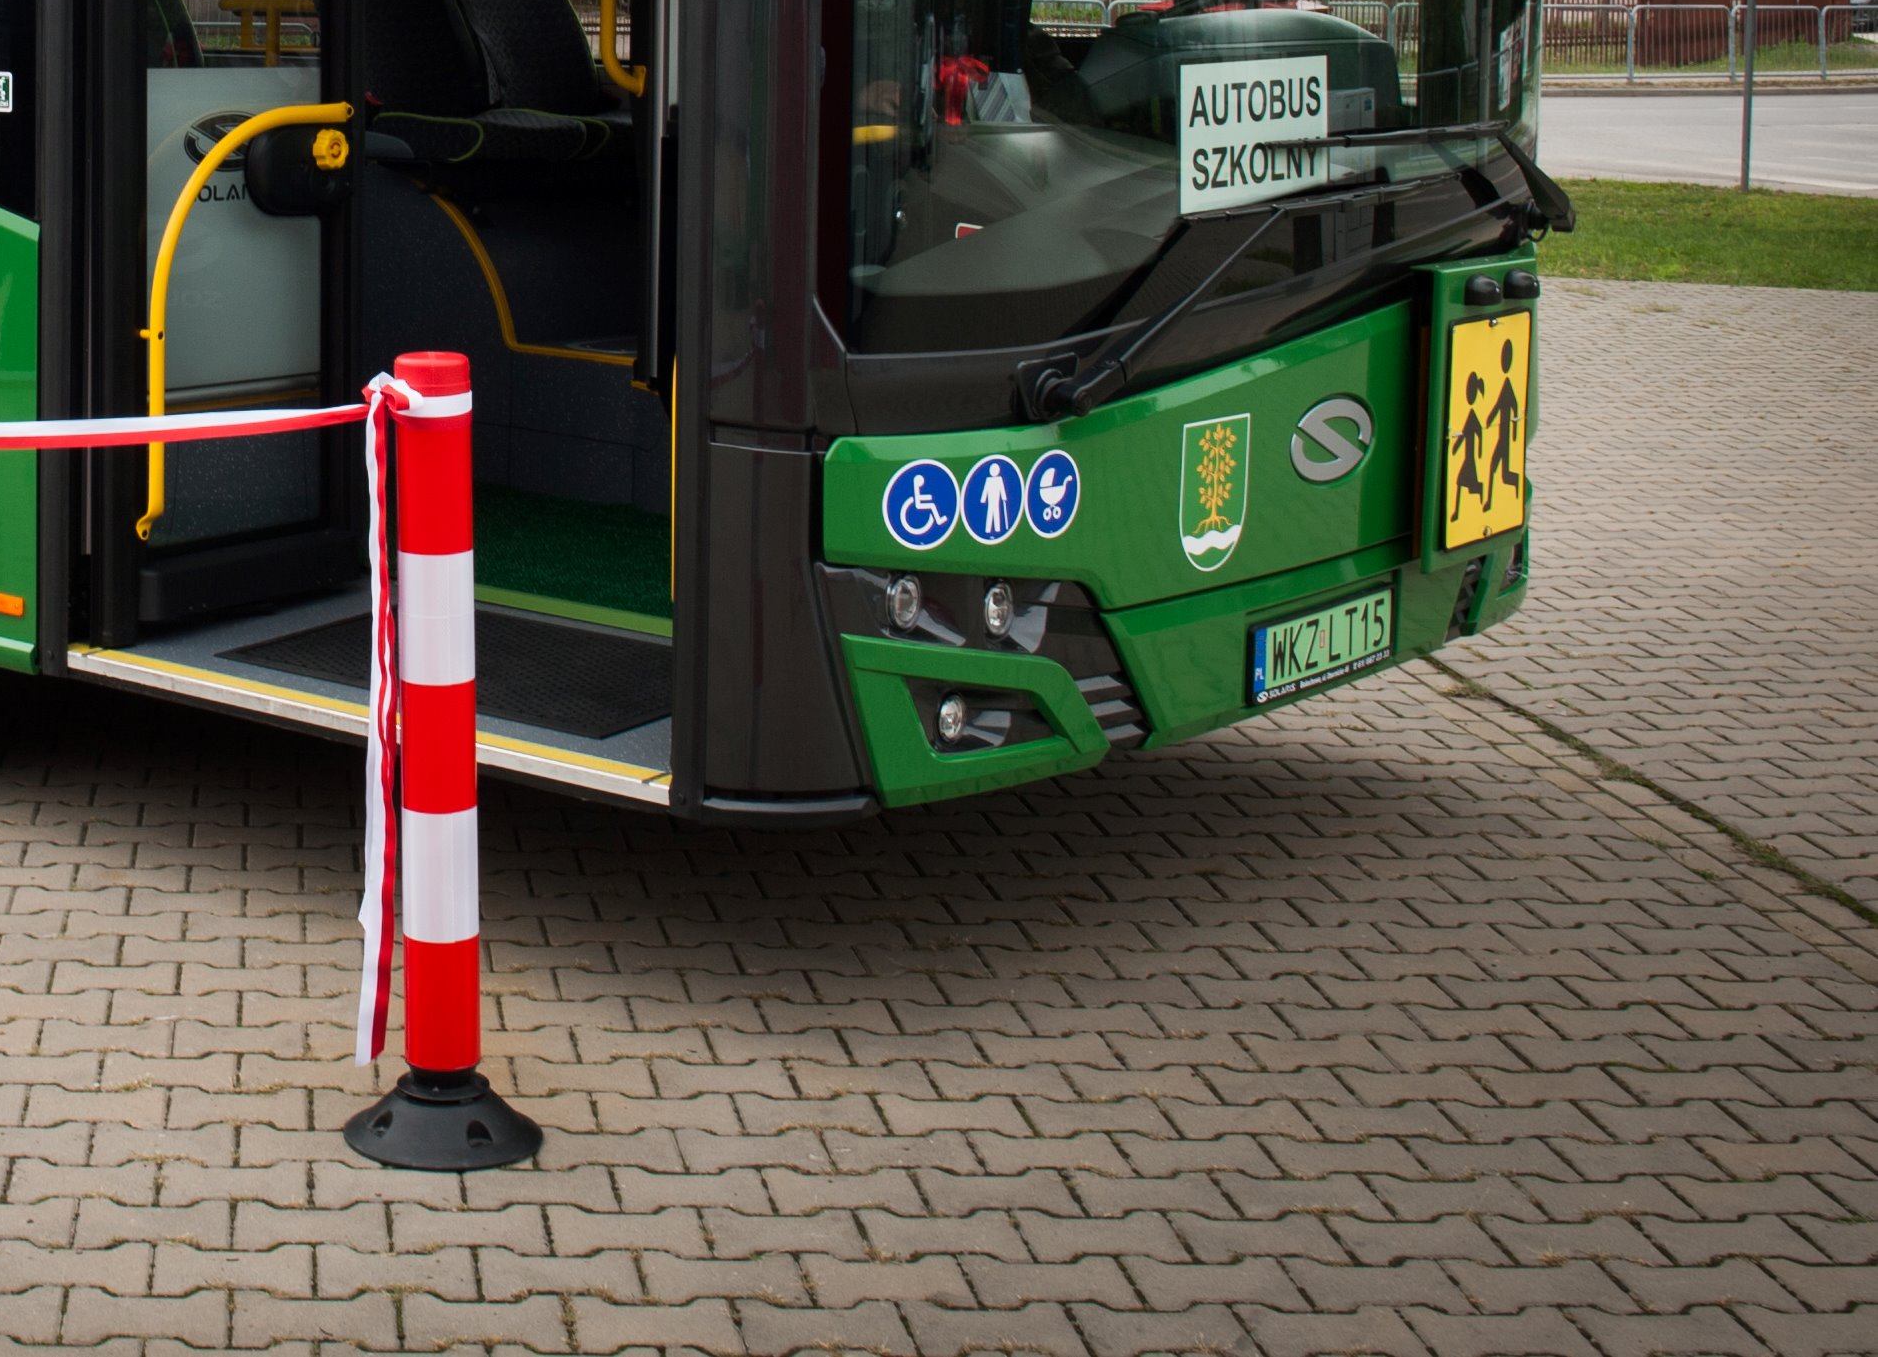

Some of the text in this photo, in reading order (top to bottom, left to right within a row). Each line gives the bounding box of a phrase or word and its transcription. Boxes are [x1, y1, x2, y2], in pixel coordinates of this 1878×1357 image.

[1188, 75, 1322, 128] AUTOBUS
[1191, 136, 1321, 191] SZKOLNY
[1272, 617, 1320, 682] WKZ
